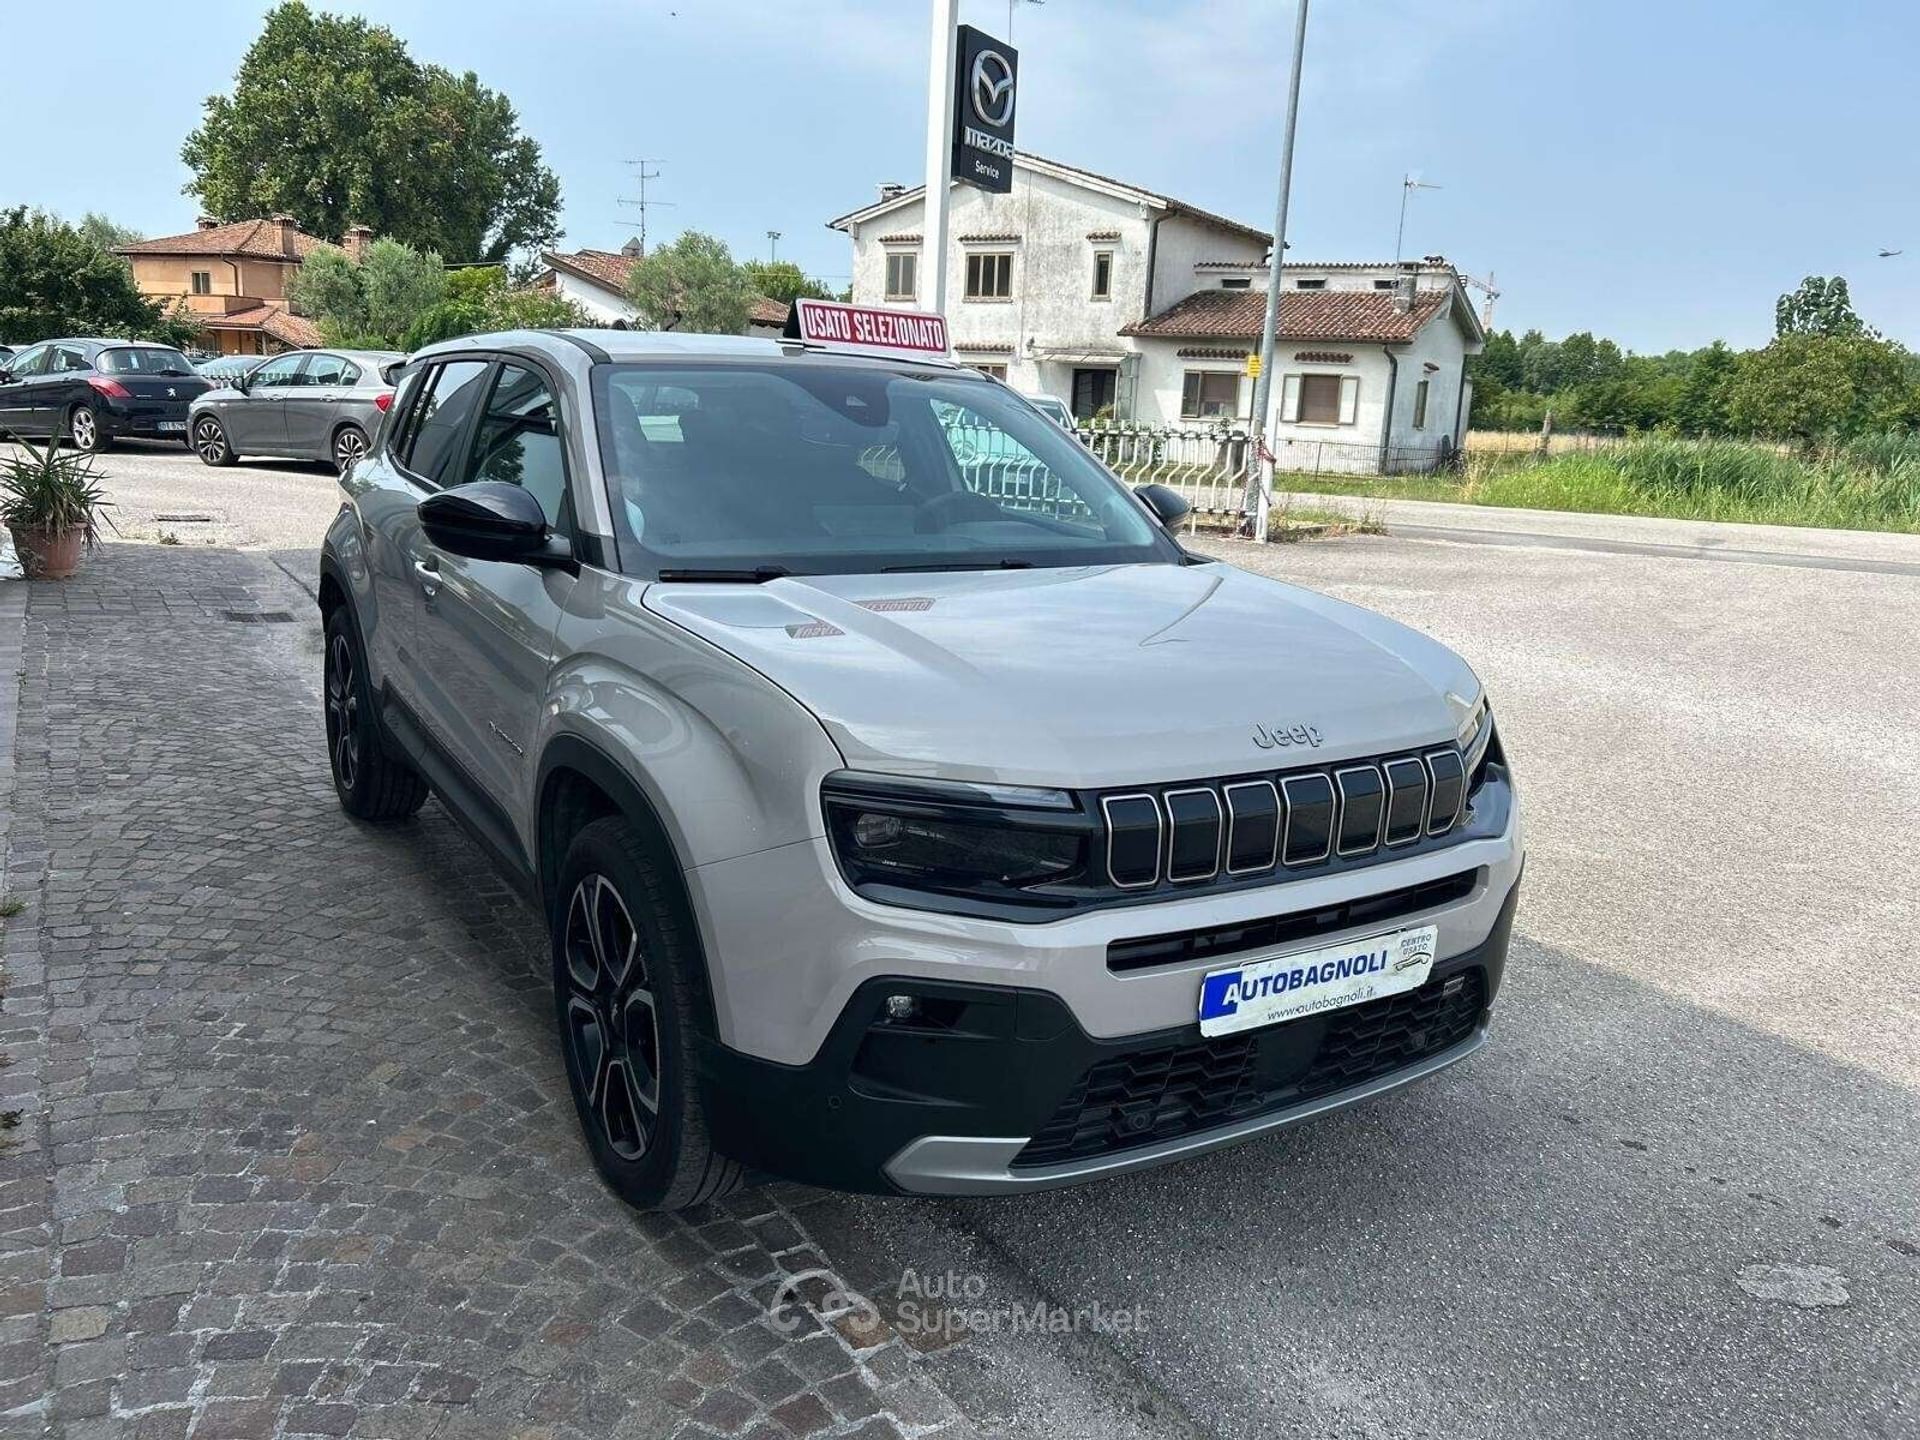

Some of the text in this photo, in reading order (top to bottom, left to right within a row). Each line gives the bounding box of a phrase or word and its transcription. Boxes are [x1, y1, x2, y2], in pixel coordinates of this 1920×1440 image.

[975, 160, 1000, 179] Service
[805, 307, 944, 349] USATO SELEZIONATO
[1252, 721, 1323, 749] Jeep
[1401, 933, 1432, 948] CENTRO
[1222, 950, 1387, 1006] AUTOBAGNOLI
[1267, 986, 1373, 1021] www.autobagnoli.it
